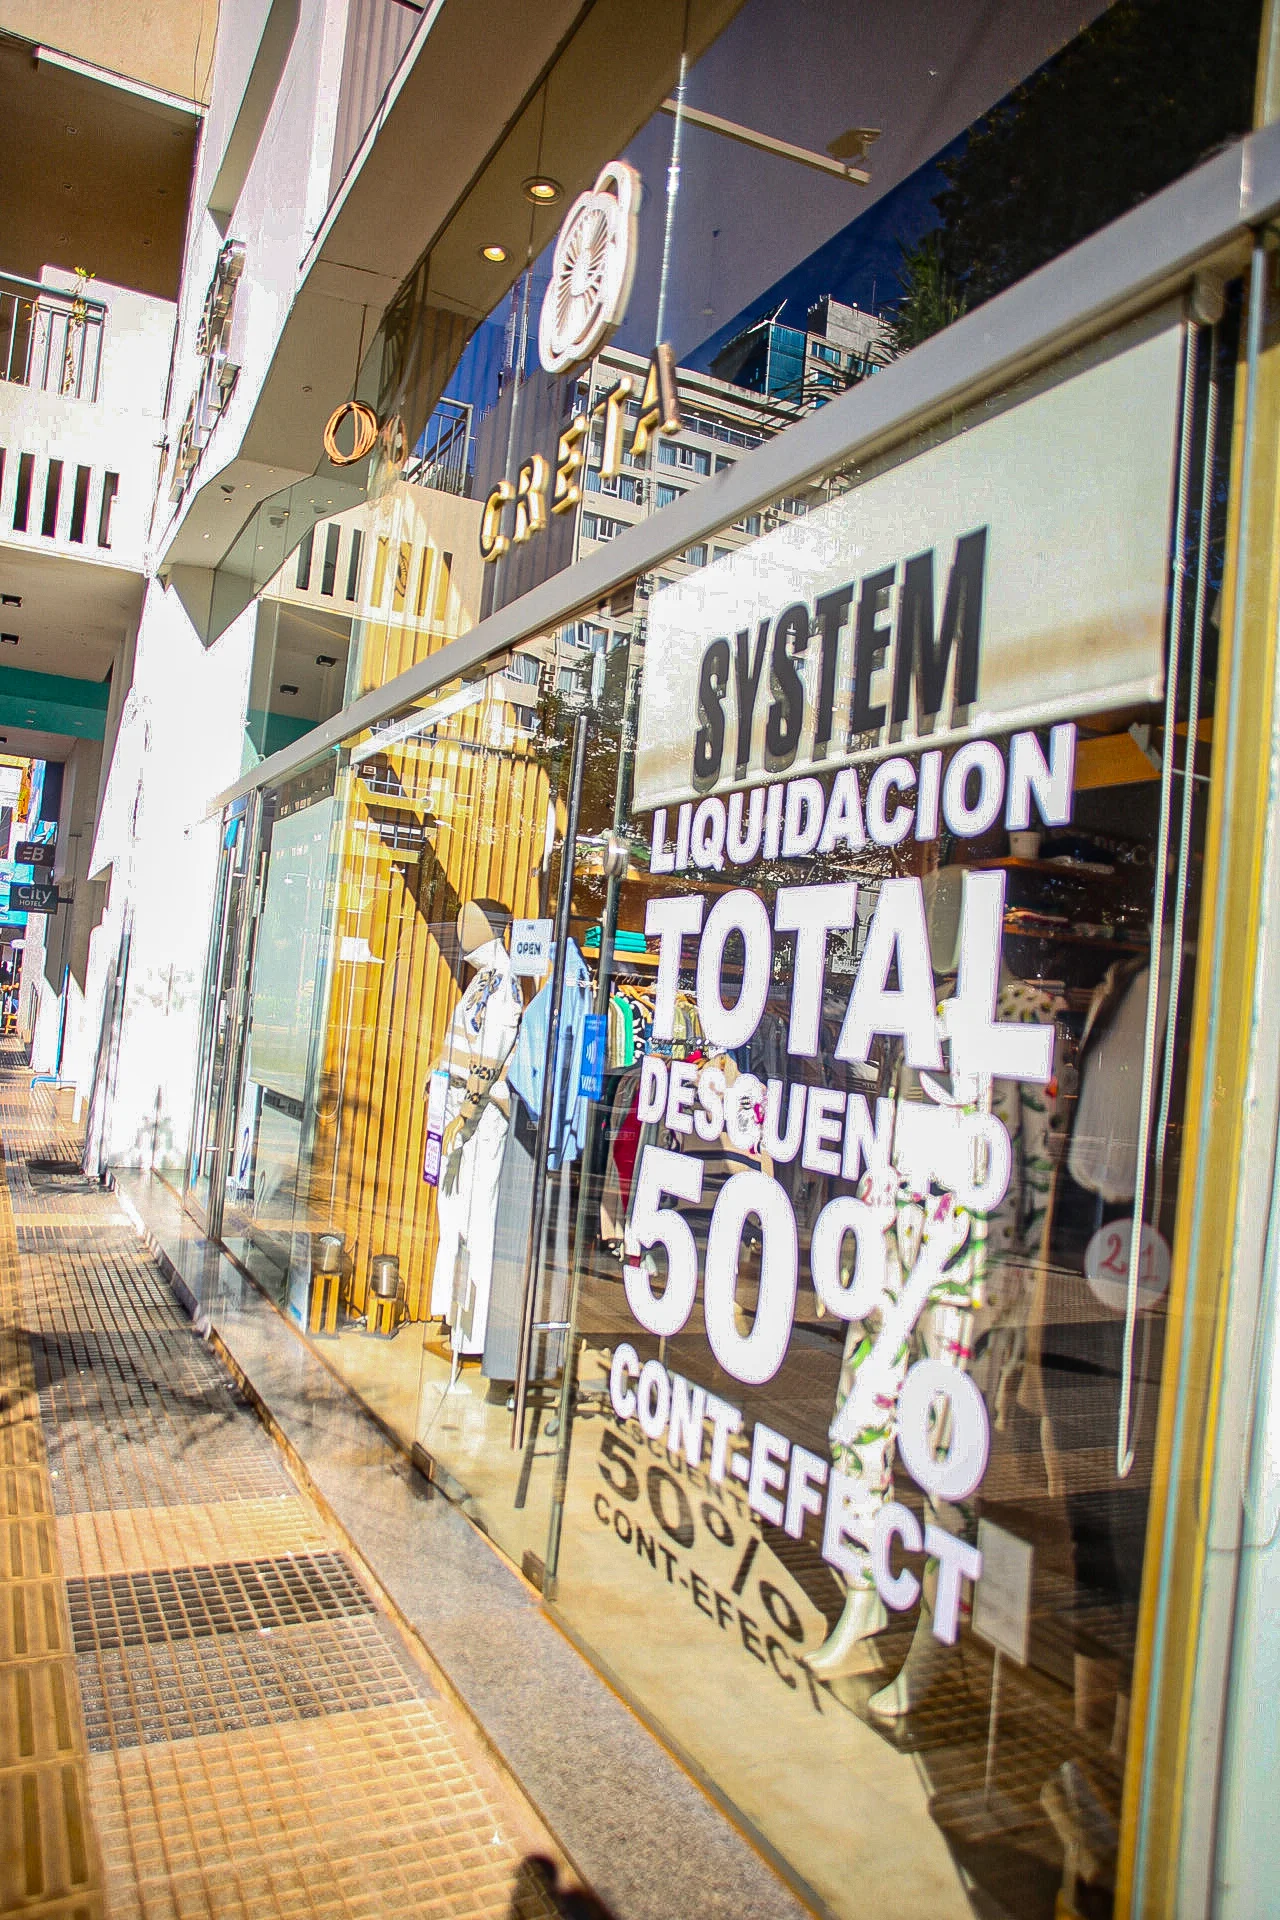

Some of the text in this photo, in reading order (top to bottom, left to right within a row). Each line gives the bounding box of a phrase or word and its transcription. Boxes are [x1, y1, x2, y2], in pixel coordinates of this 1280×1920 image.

[479, 342, 682, 563] CRETA
[694, 525, 988, 788] SYSTEM
[17, 886, 52, 904] City
[18, 899, 43, 908] HOTEL
[649, 723, 1078, 876] LIQUIDACION
[516, 941, 542, 956] OPEN
[645, 869, 1055, 1085] TOTAL
[622, 1144, 991, 1501] 50%
[609, 1343, 983, 1646] CONT-EFECT
